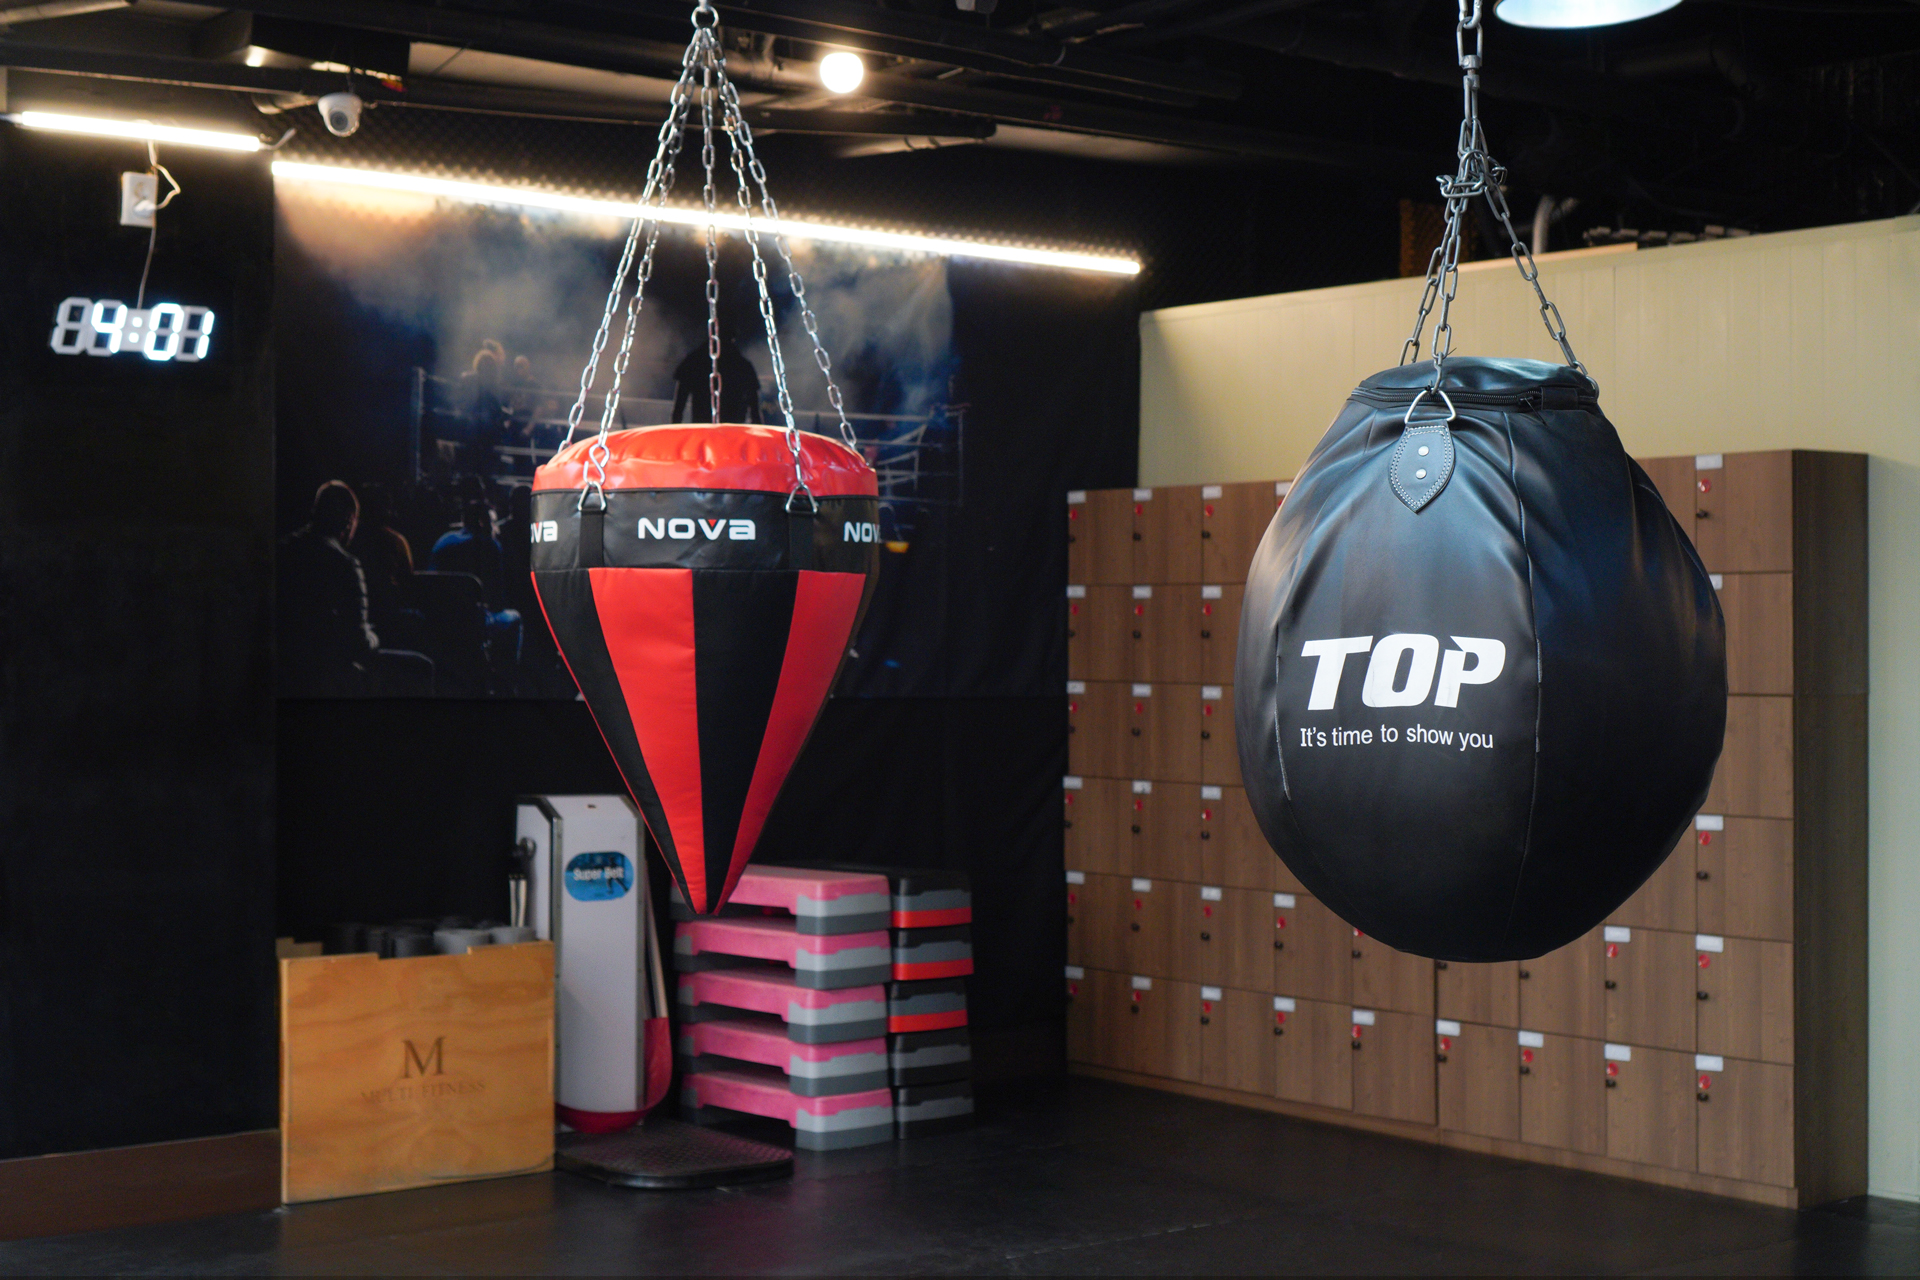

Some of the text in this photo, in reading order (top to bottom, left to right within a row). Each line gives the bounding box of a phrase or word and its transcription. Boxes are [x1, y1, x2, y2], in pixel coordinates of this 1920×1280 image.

[91, 302, 215, 361] 4:01
[1301, 633, 1506, 711] TOP
[1300, 724, 1494, 751] It's time to show you
[402, 1035, 446, 1079] M
